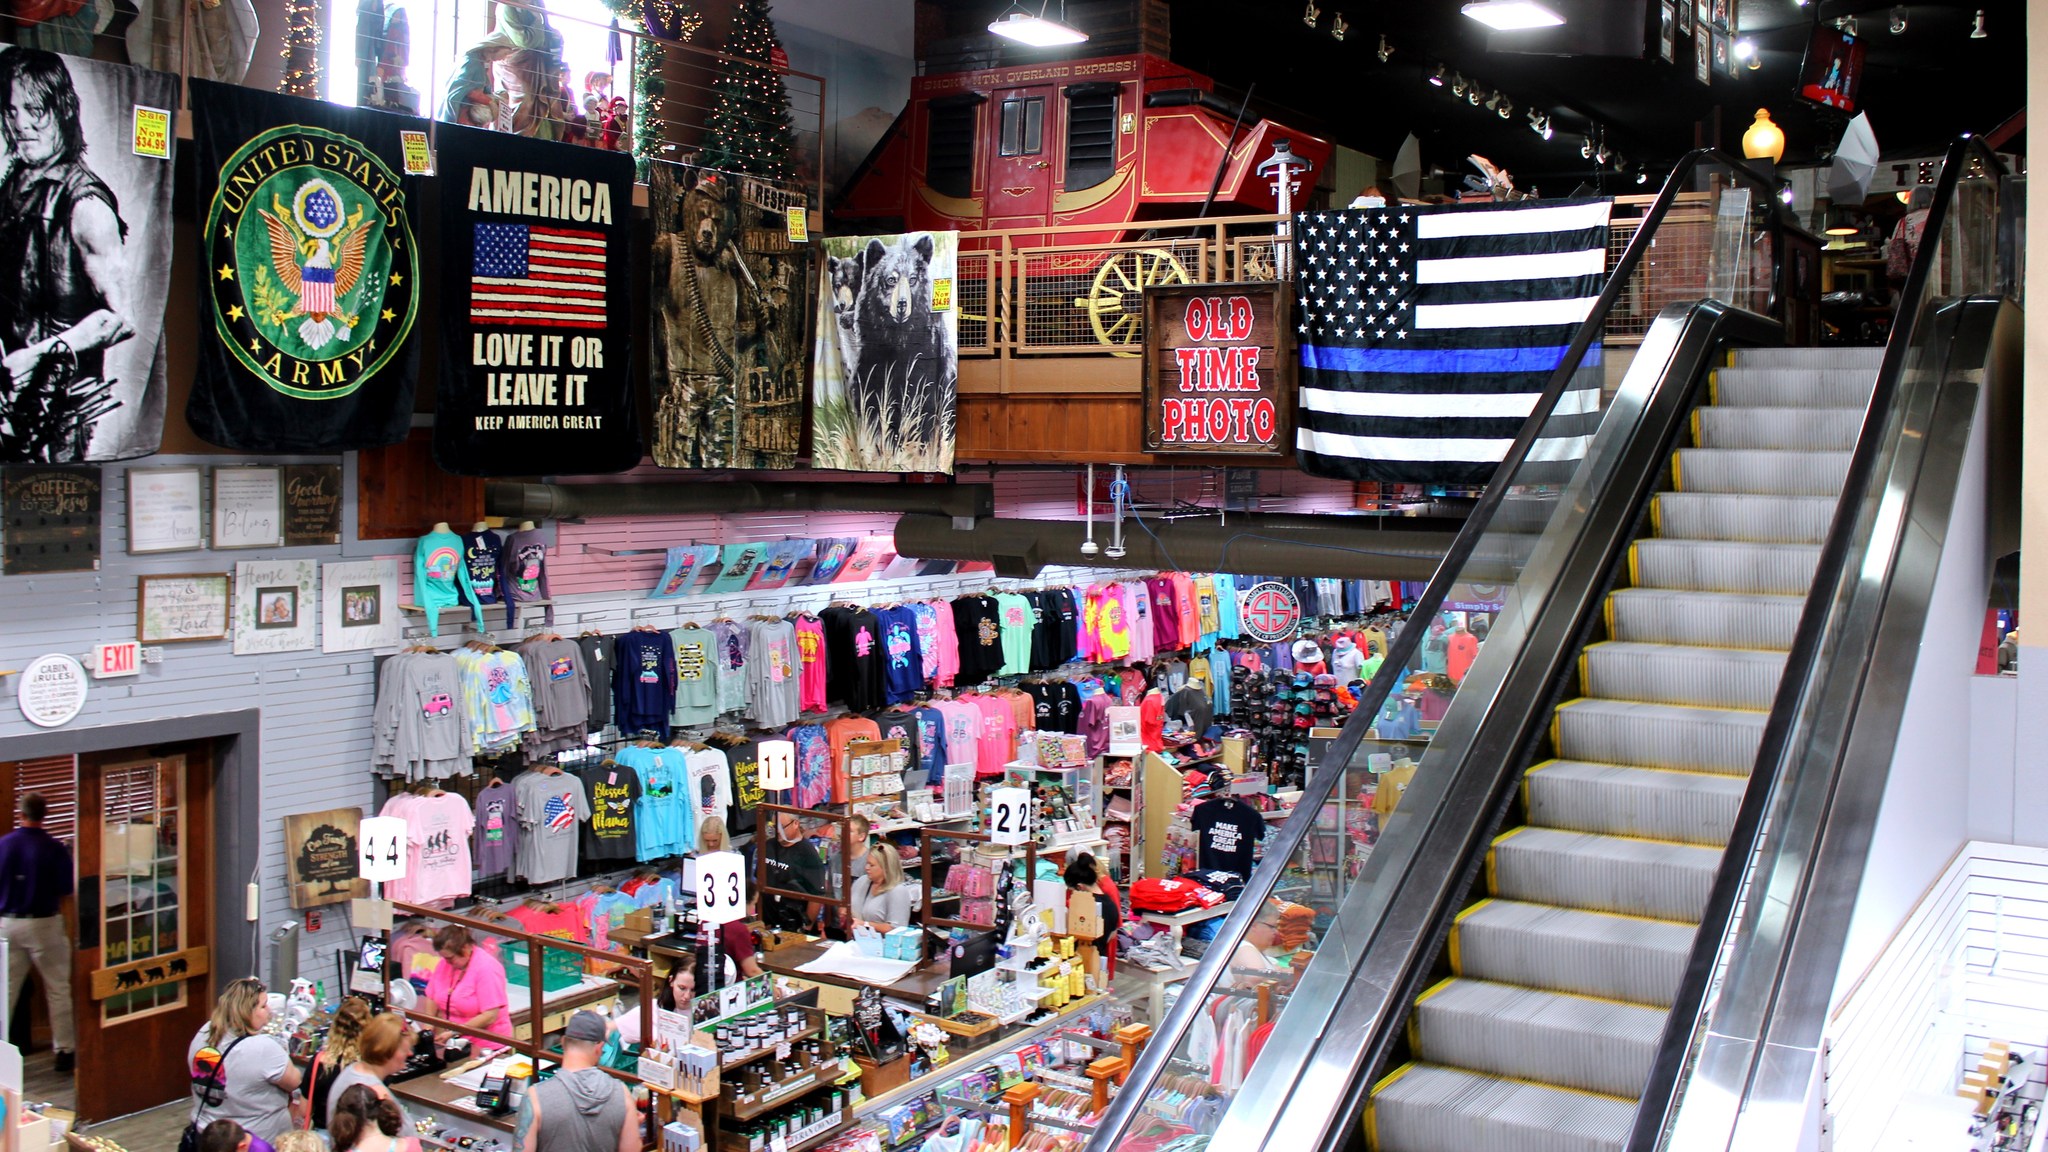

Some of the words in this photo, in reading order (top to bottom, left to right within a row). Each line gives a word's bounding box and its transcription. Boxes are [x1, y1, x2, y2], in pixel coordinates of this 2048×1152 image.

[1006, 66, 1070, 82] OVERLAND
[1074, 60, 1137, 76] EXPRESS!
[139, 110, 166, 121] Sale
[139, 127, 164, 138] Now
[404, 133, 425, 142] SALE
[136, 135, 166, 150] $34.99
[222, 139, 315, 213] UNITED
[468, 166, 612, 225] AMERICA
[746, 231, 766, 251] MY
[1184, 296, 1255, 342] OLD
[473, 333, 534, 367] LOVE
[540, 335, 564, 367] IT
[571, 336, 604, 369] OR
[263, 347, 365, 386] ARMY
[1175, 347, 1261, 392] TIME
[487, 373, 558, 406] LEAVE
[565, 374, 589, 406] IT
[749, 370, 799, 402] BEAR
[475, 416, 504, 430] KEEP
[508, 415, 560, 430] AMERICA
[562, 415, 603, 430] GREAT
[1162, 398, 1276, 443] PHOTO
[744, 417, 800, 451] ARMS
[32, 480, 80, 495] COFFEE
[288, 477, 326, 506] Good
[1454, 602, 1490, 611] Simply
[103, 644, 135, 673] EXIT
[38, 672, 70, 682] RULES
[40, 663, 68, 674] CABIN
[594, 782, 629, 798] Blessed
[592, 811, 630, 831] Mama
[1215, 822, 1238, 832] MAKE
[1208, 827, 1242, 840] AMERICA
[1212, 835, 1237, 846] GREAT
[310, 849, 348, 862] STRENGTH
[1210, 842, 1237, 852] AGAIN!
